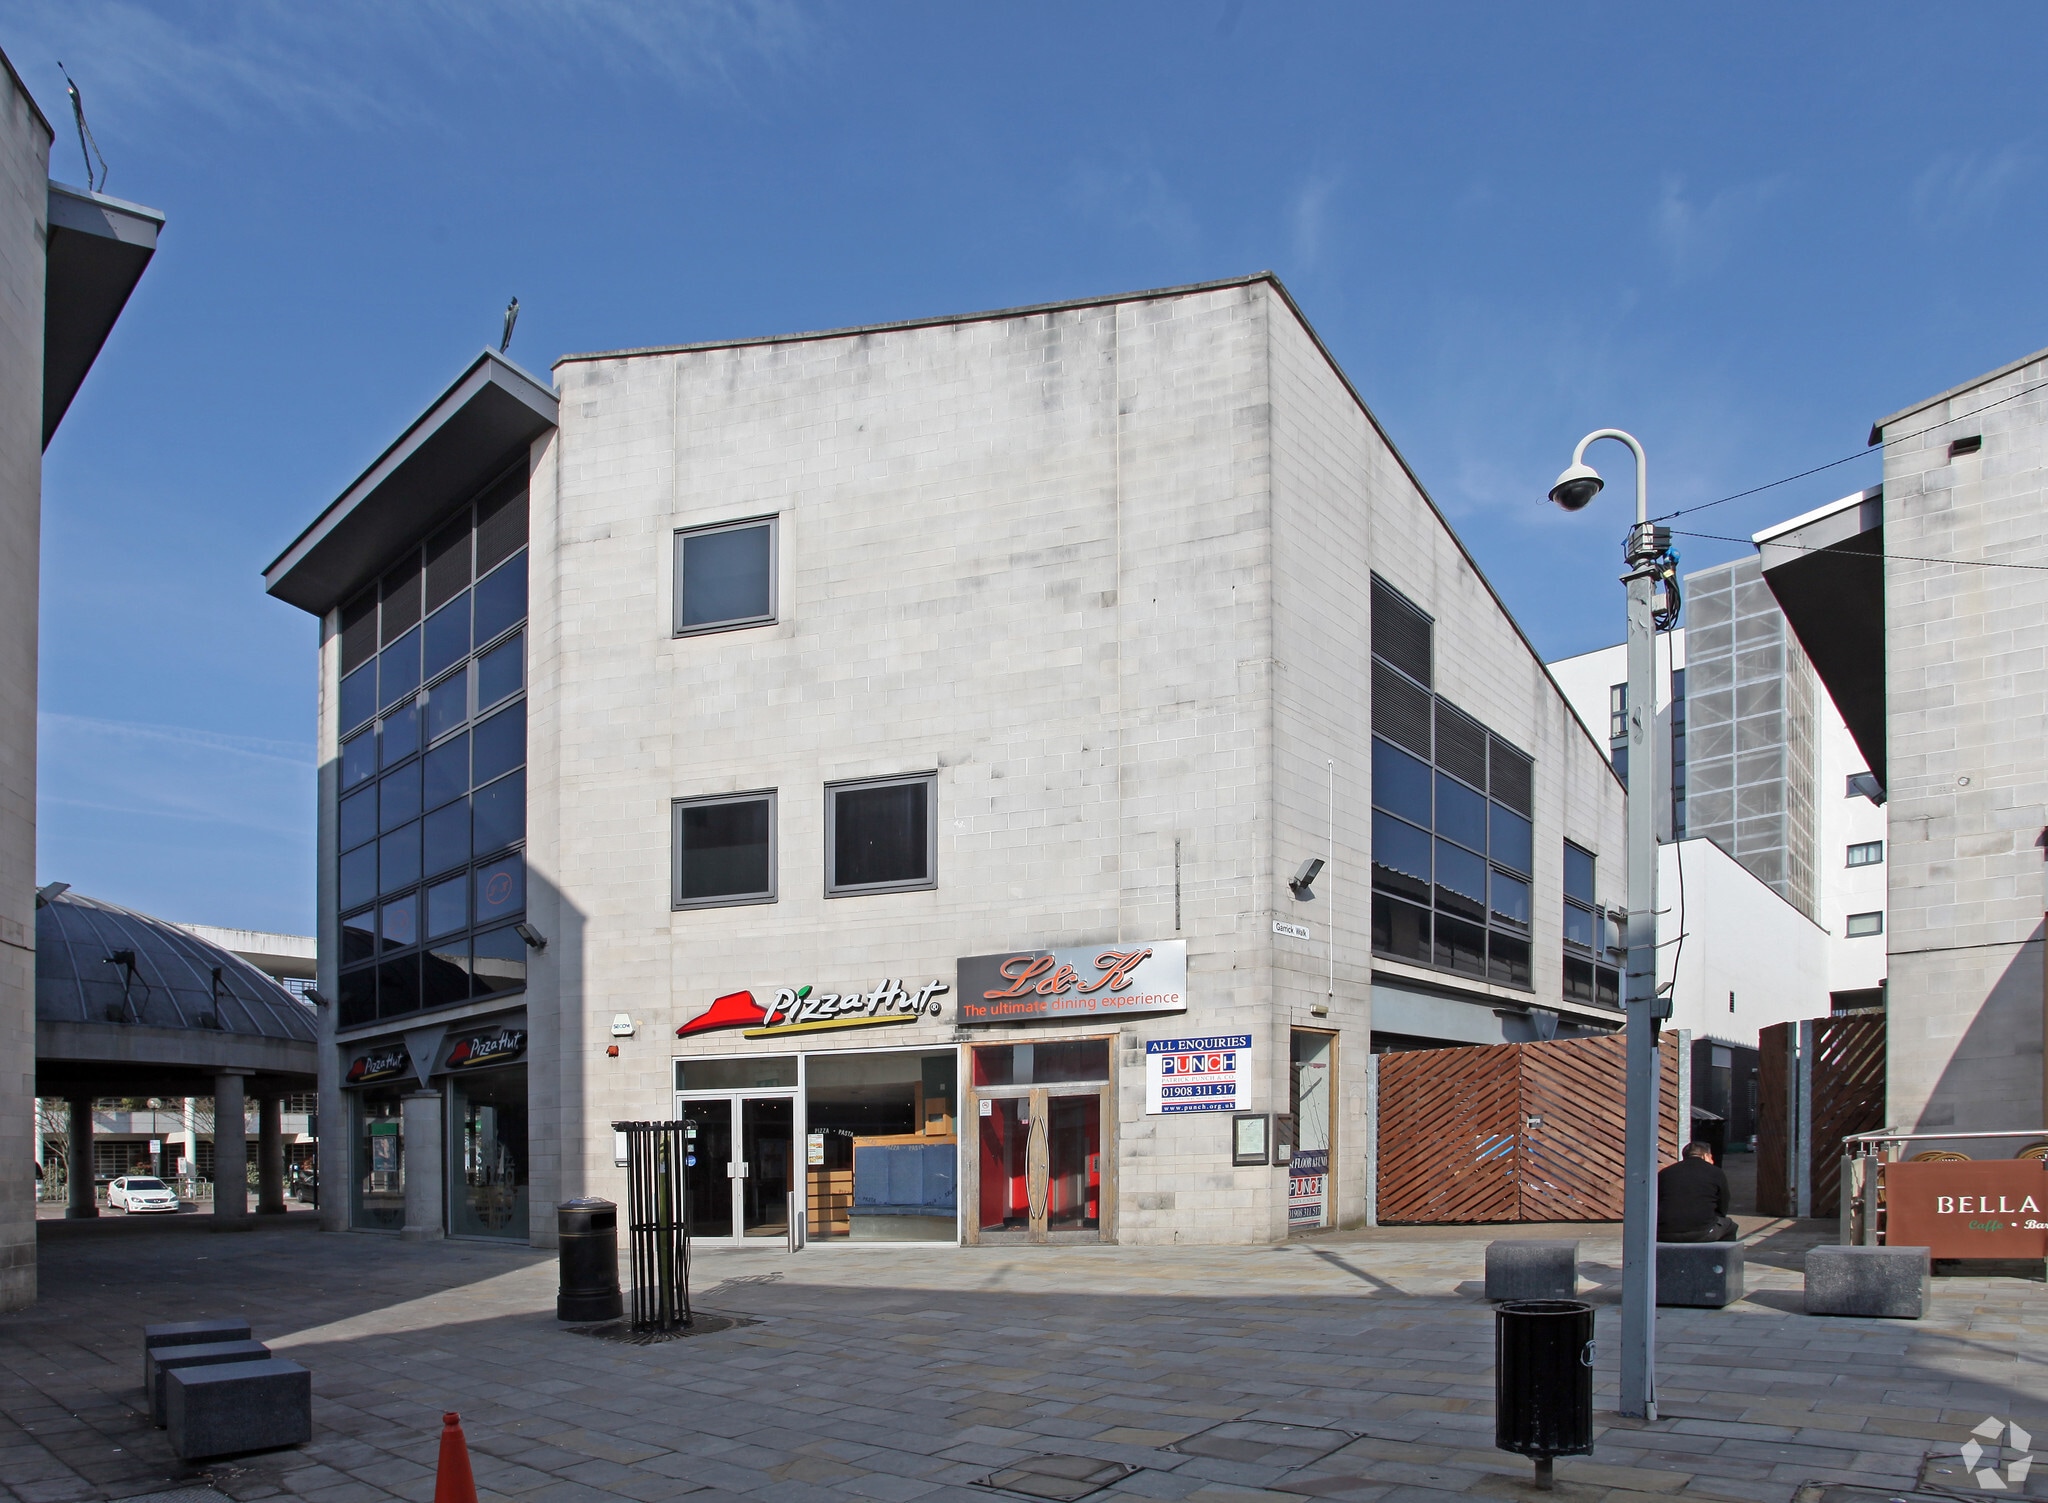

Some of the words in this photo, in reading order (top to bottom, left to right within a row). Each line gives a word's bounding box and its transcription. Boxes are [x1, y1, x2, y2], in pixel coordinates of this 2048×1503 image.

[763, 985, 866, 1026] Pizza
[867, 978, 950, 1012] Hut
[963, 1004, 987, 1017] The
[990, 1000, 1048, 1015] ultimate
[1051, 996, 1097, 1010] dining
[1101, 992, 1180, 1008] experience
[469, 1038, 498, 1058] Pizza
[498, 1031, 523, 1050] Hut
[1150, 1040, 1176, 1052] ALL
[1178, 1036, 1247, 1051] ENQUIRIES
[364, 1056, 386, 1074] Pizza
[385, 1052, 404, 1069] Hut
[1162, 1053, 1236, 1074] PUNCH
[1162, 1086, 1193, 1097] 01908
[1195, 1085, 1213, 1096] 311
[1216, 1084, 1235, 1095] 517
[1163, 1103, 1234, 1111] www.punch.org.uk
[838, 1129, 854, 1137] PASTA
[1289, 1178, 1322, 1196] PUNCH
[1937, 1195, 2040, 1213] BELLA
[1969, 1220, 2004, 1232] Caffe
